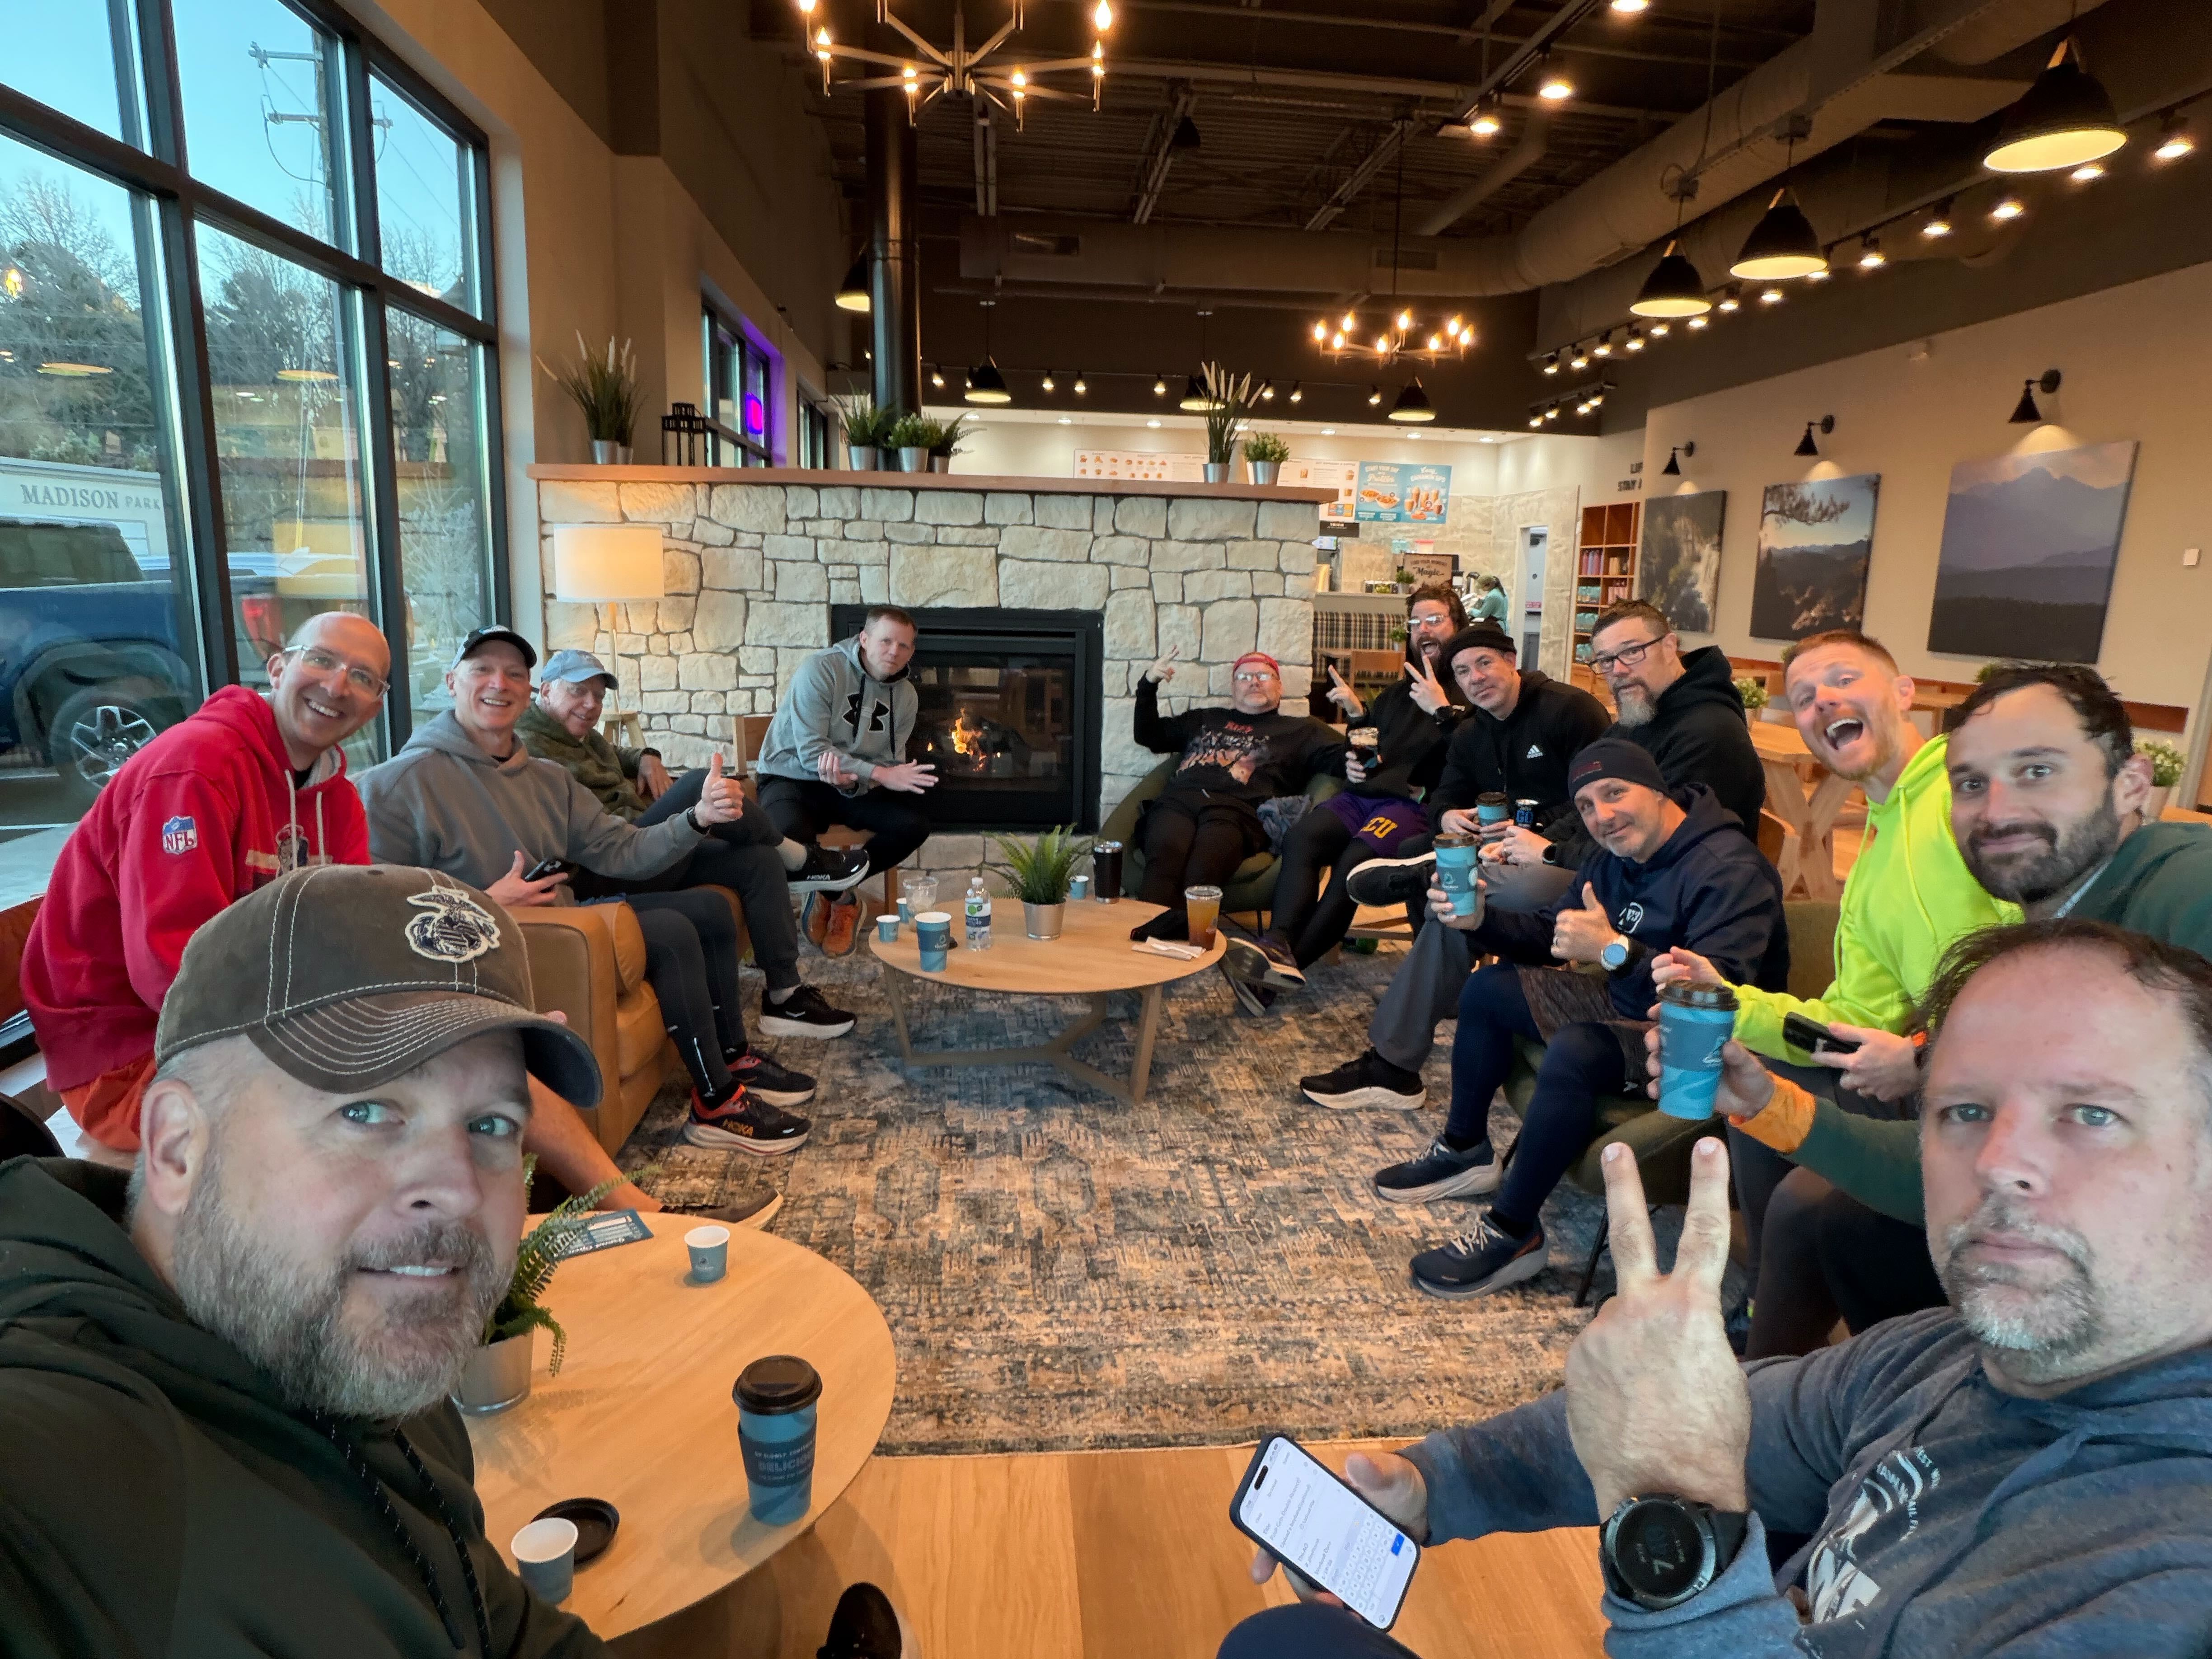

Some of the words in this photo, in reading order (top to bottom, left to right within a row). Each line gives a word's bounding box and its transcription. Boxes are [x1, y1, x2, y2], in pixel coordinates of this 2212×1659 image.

[20, 484, 119, 509] MADISON
[125, 496, 160, 510] PARK
[165, 831, 194, 850] NFL
[723, 1118, 753, 1136] HOKA
